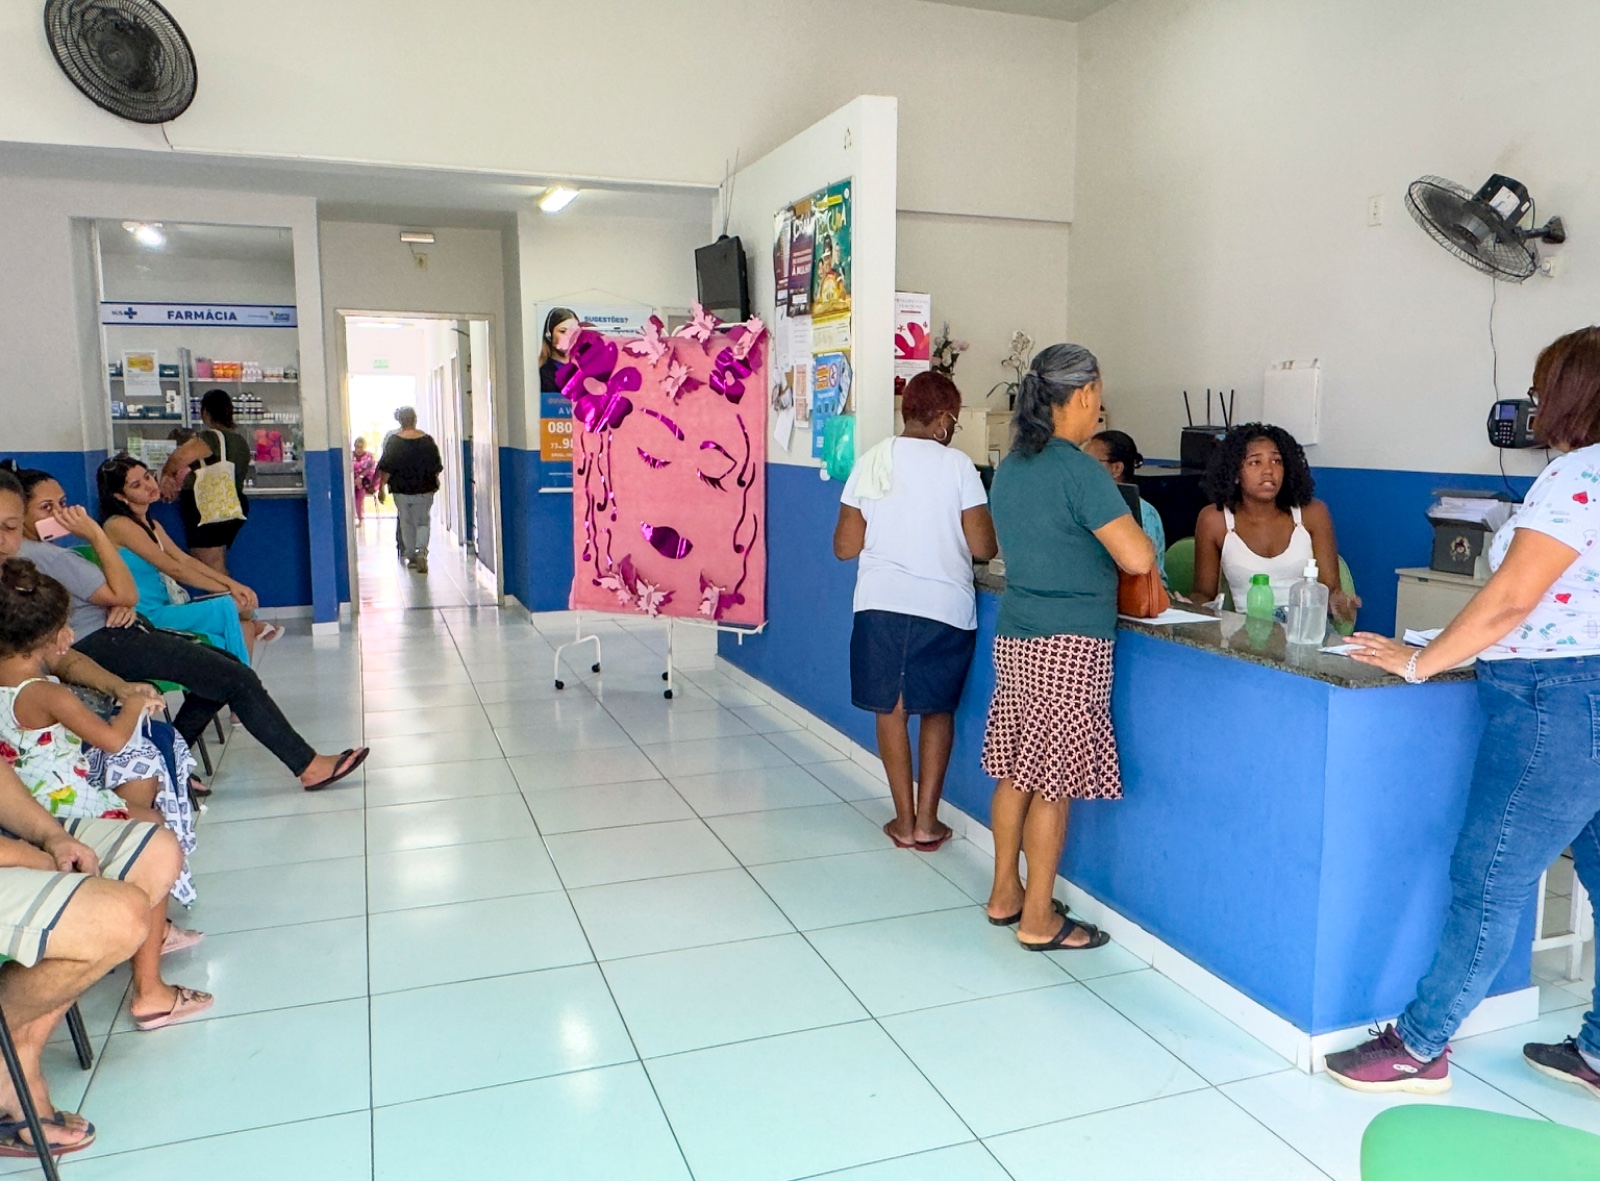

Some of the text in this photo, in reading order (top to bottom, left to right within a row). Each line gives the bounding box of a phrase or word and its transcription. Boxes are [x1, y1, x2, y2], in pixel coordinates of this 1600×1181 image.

[167, 309, 238, 321] FARMÁCIA
[584, 315, 628, 324] SUGESTÕES?
[547, 421, 573, 433] 080
